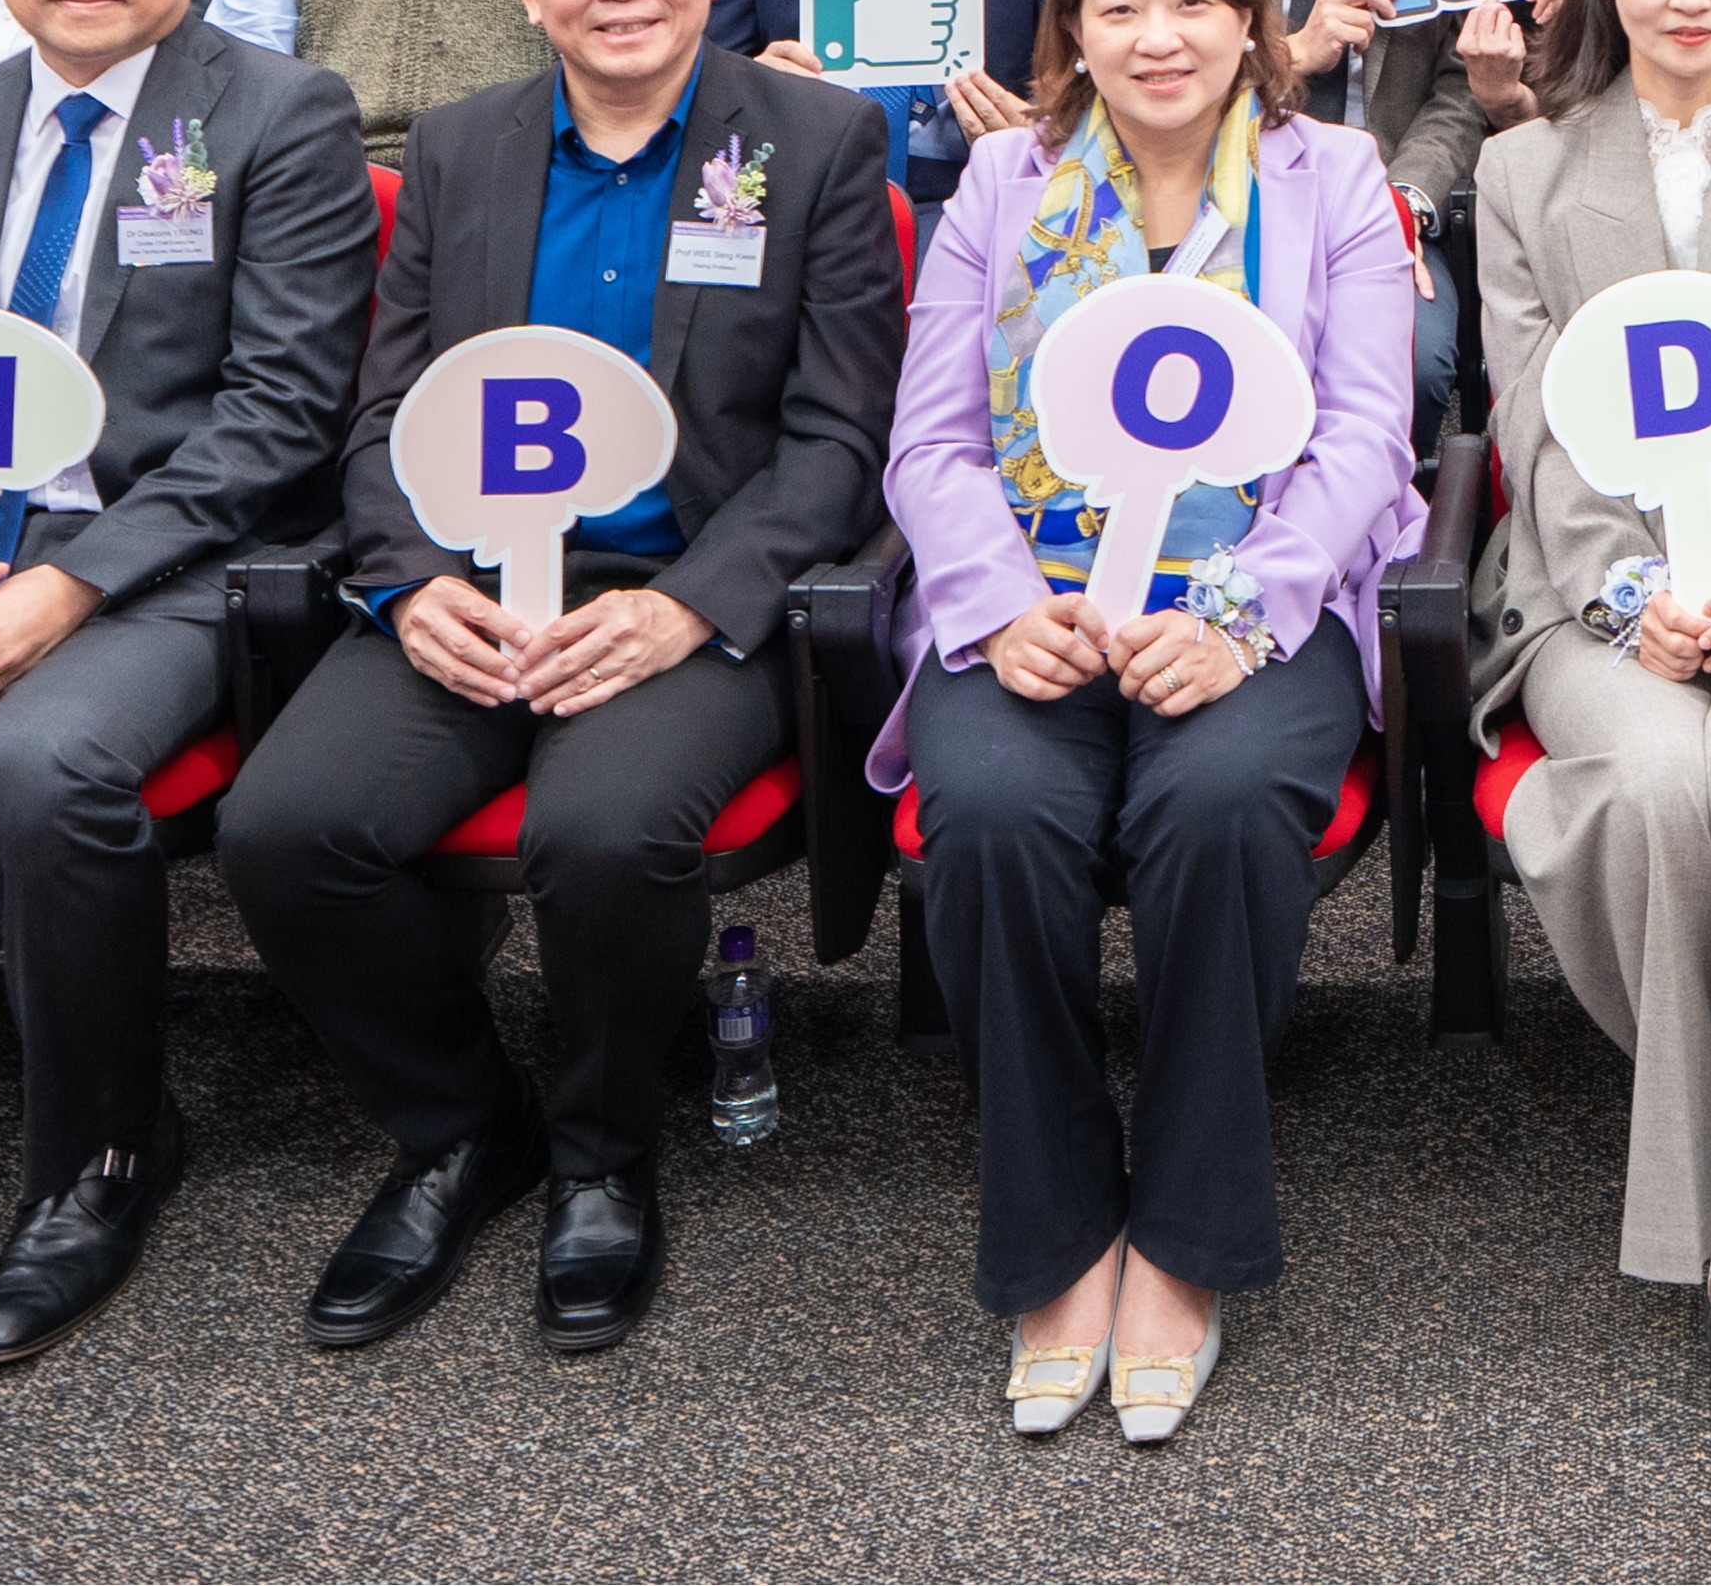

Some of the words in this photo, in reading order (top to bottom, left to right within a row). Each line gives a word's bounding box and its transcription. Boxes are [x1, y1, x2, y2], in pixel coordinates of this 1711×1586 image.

[675, 248, 690, 256] Prof
[693, 249, 713, 258] WEE
[481, 378, 586, 495] B
[1113, 325, 1234, 449] O
